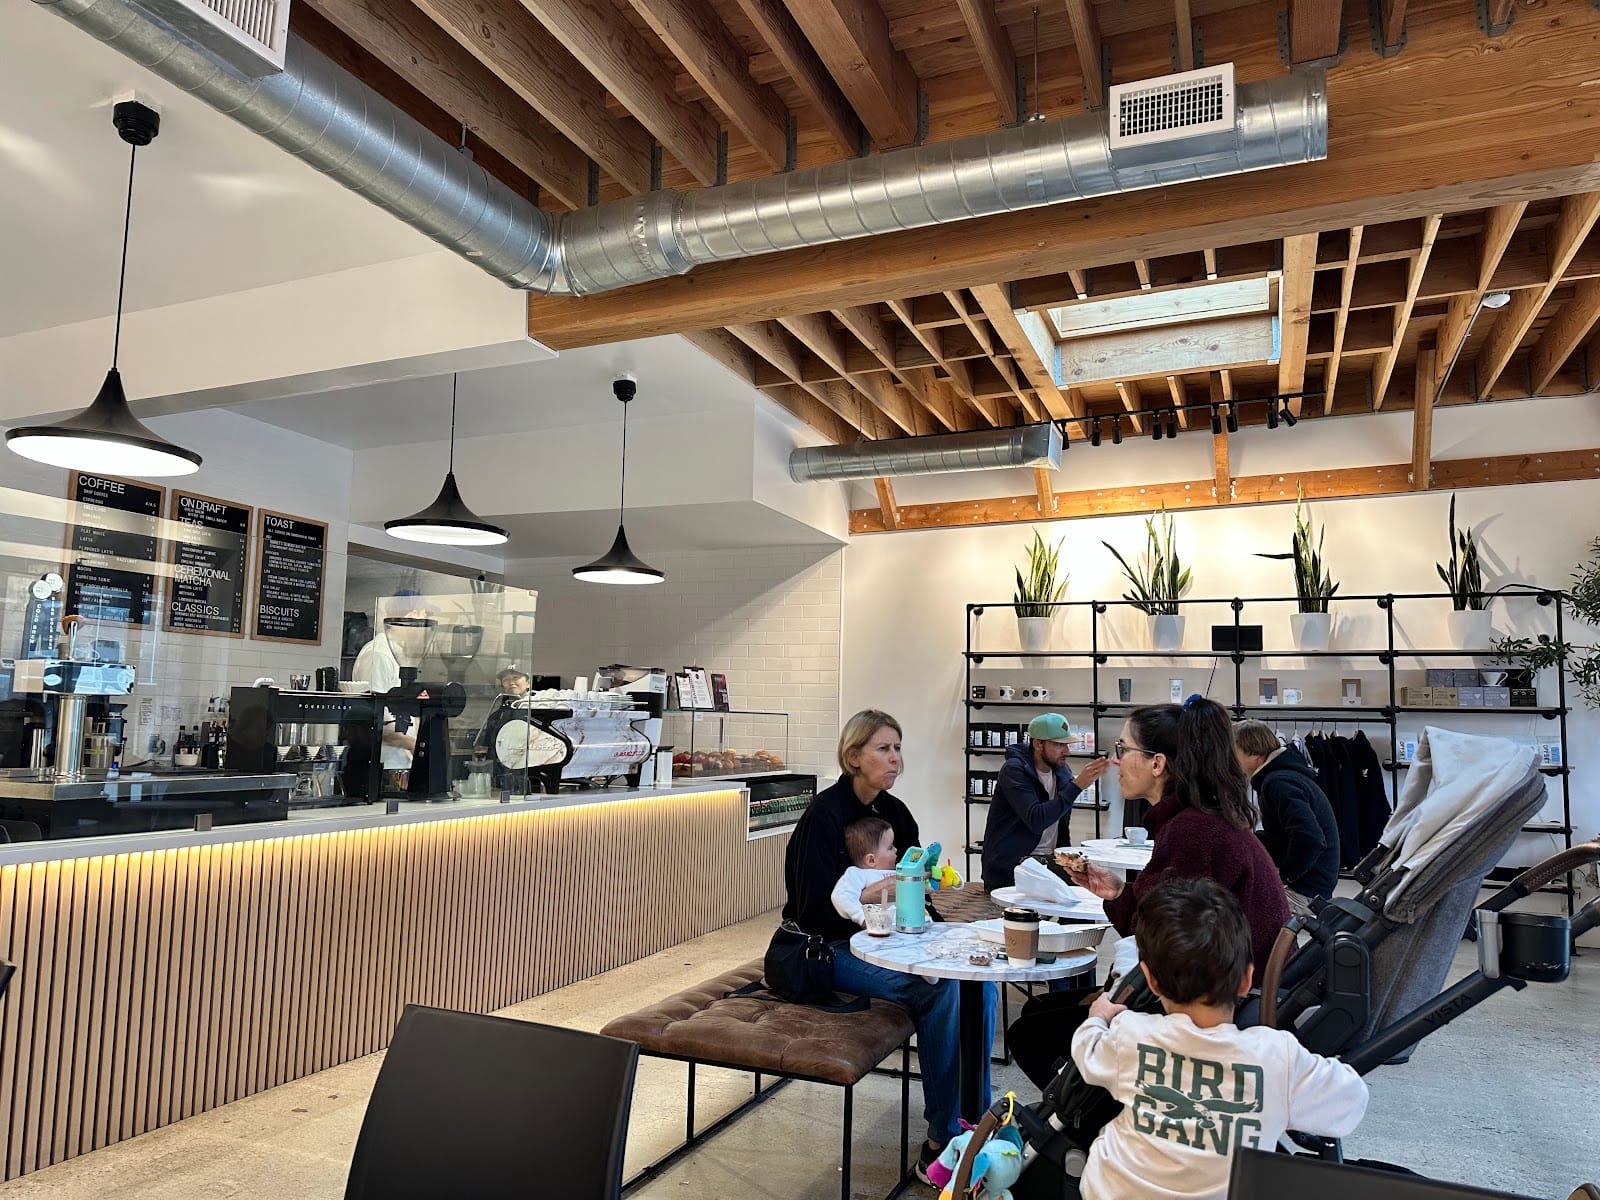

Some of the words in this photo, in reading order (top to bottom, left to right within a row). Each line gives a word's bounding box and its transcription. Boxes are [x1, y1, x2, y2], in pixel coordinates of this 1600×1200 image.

[79, 475, 125, 495] COFFEE
[180, 497, 195, 509] ON
[195, 500, 228, 515] DRAFT
[179, 516, 204, 530] TEAS
[266, 515, 294, 530] TOAST
[174, 563, 231, 581] CEREMONIAL
[174, 573, 212, 588] MATCHA
[171, 601, 220, 616] CLASSICS
[259, 604, 300, 618] BISCUITS
[1423, 994, 1472, 1023] VISTA
[1135, 1042, 1264, 1113] BIRD
[1131, 1094, 1262, 1156] GANG
